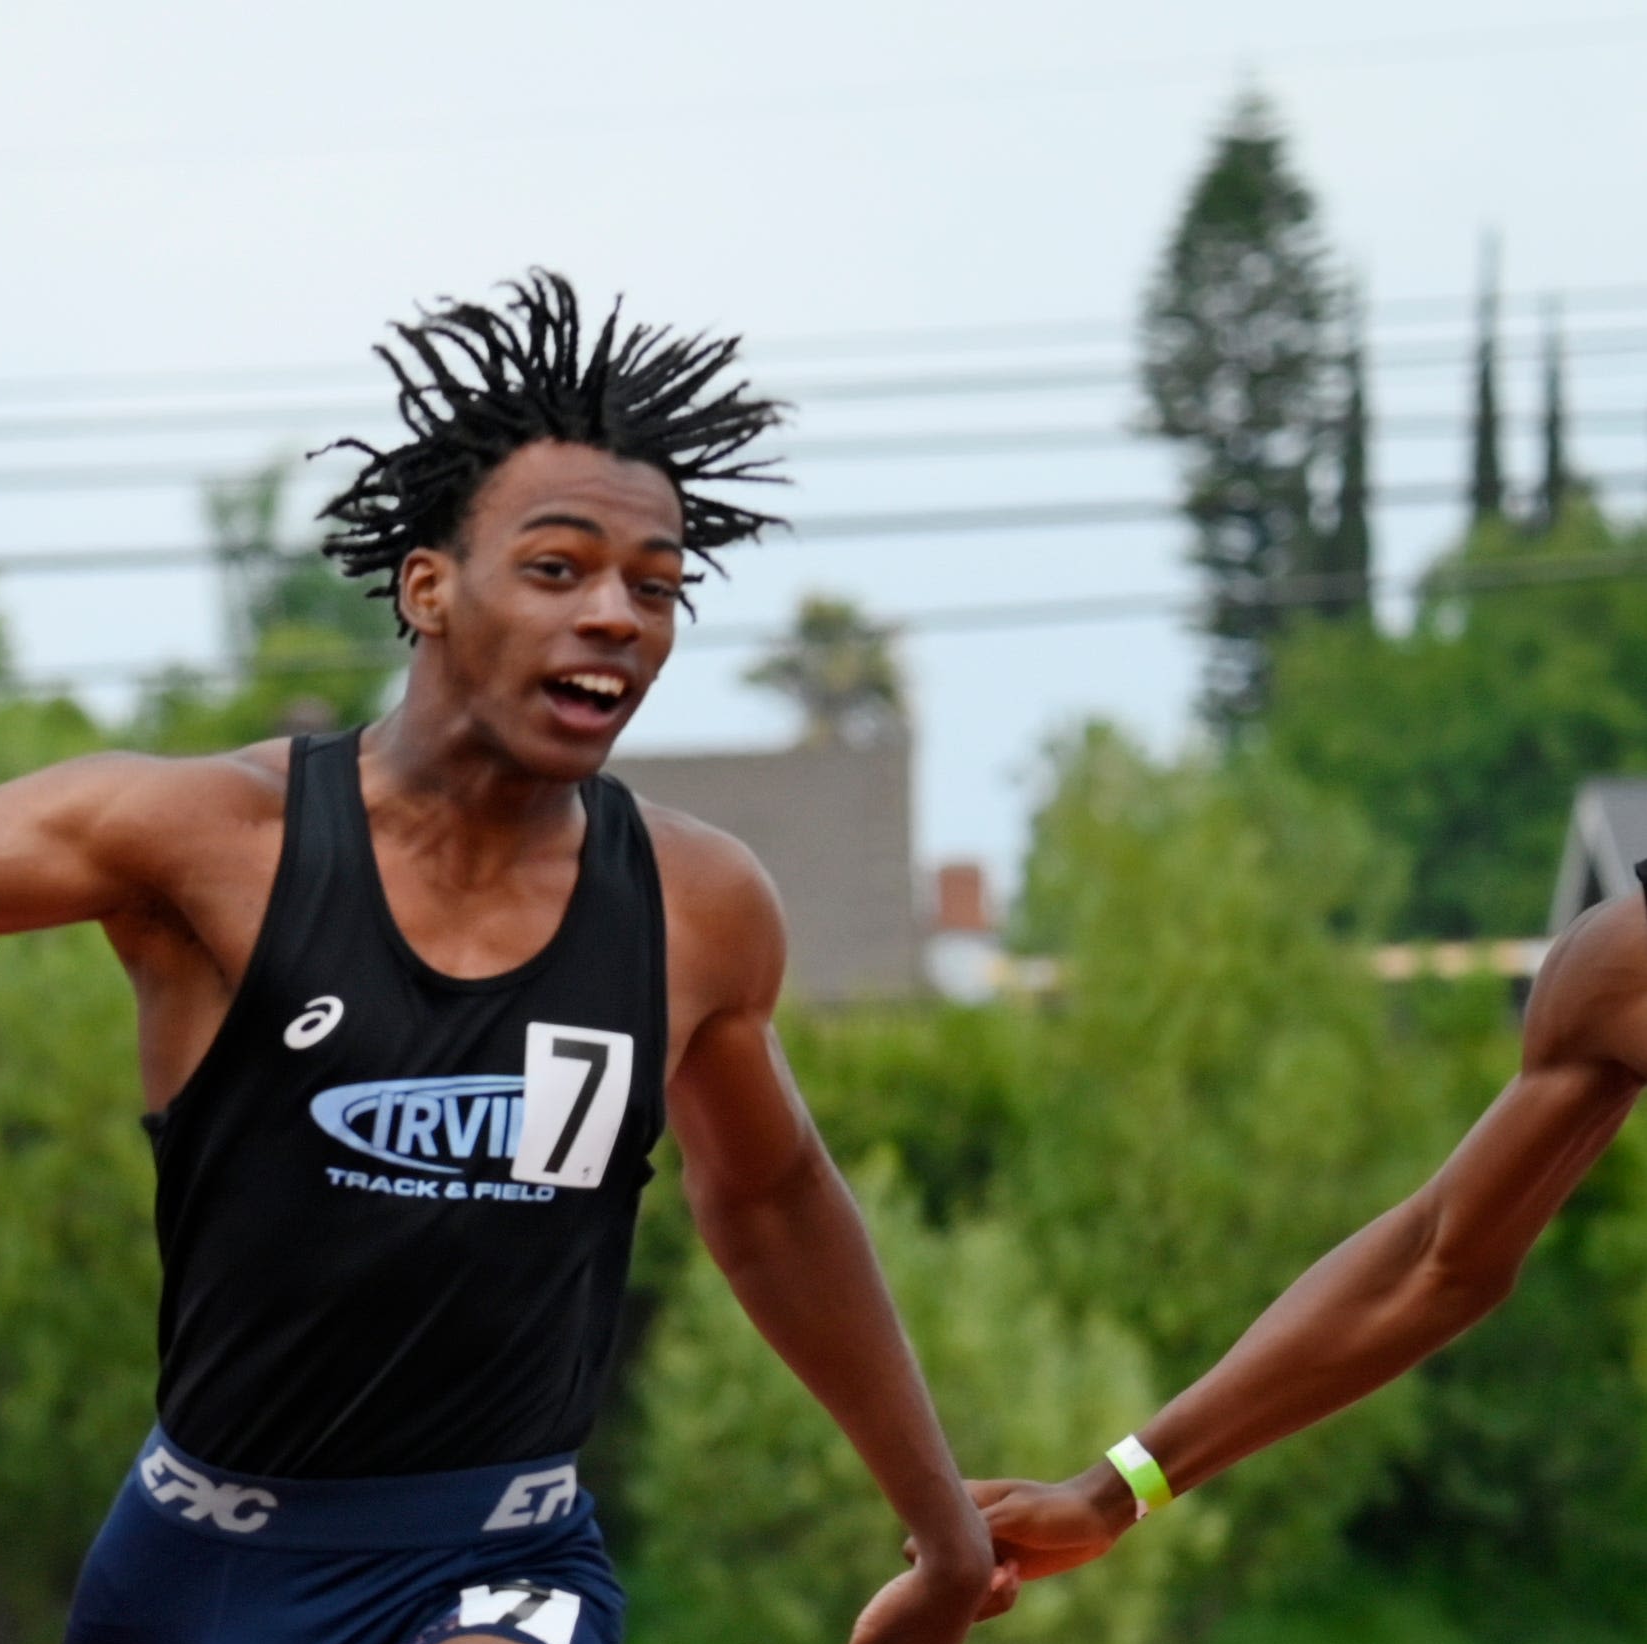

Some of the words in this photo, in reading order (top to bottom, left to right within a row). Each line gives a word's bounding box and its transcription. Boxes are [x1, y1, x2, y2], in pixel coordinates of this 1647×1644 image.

[370, 1090, 526, 1159] IRVI
[543, 1036, 610, 1174] 7
[325, 1166, 440, 1199] TRACK
[444, 1181, 469, 1200] &
[473, 1183, 556, 1202] FIELD
[139, 1445, 280, 1535] EPIC
